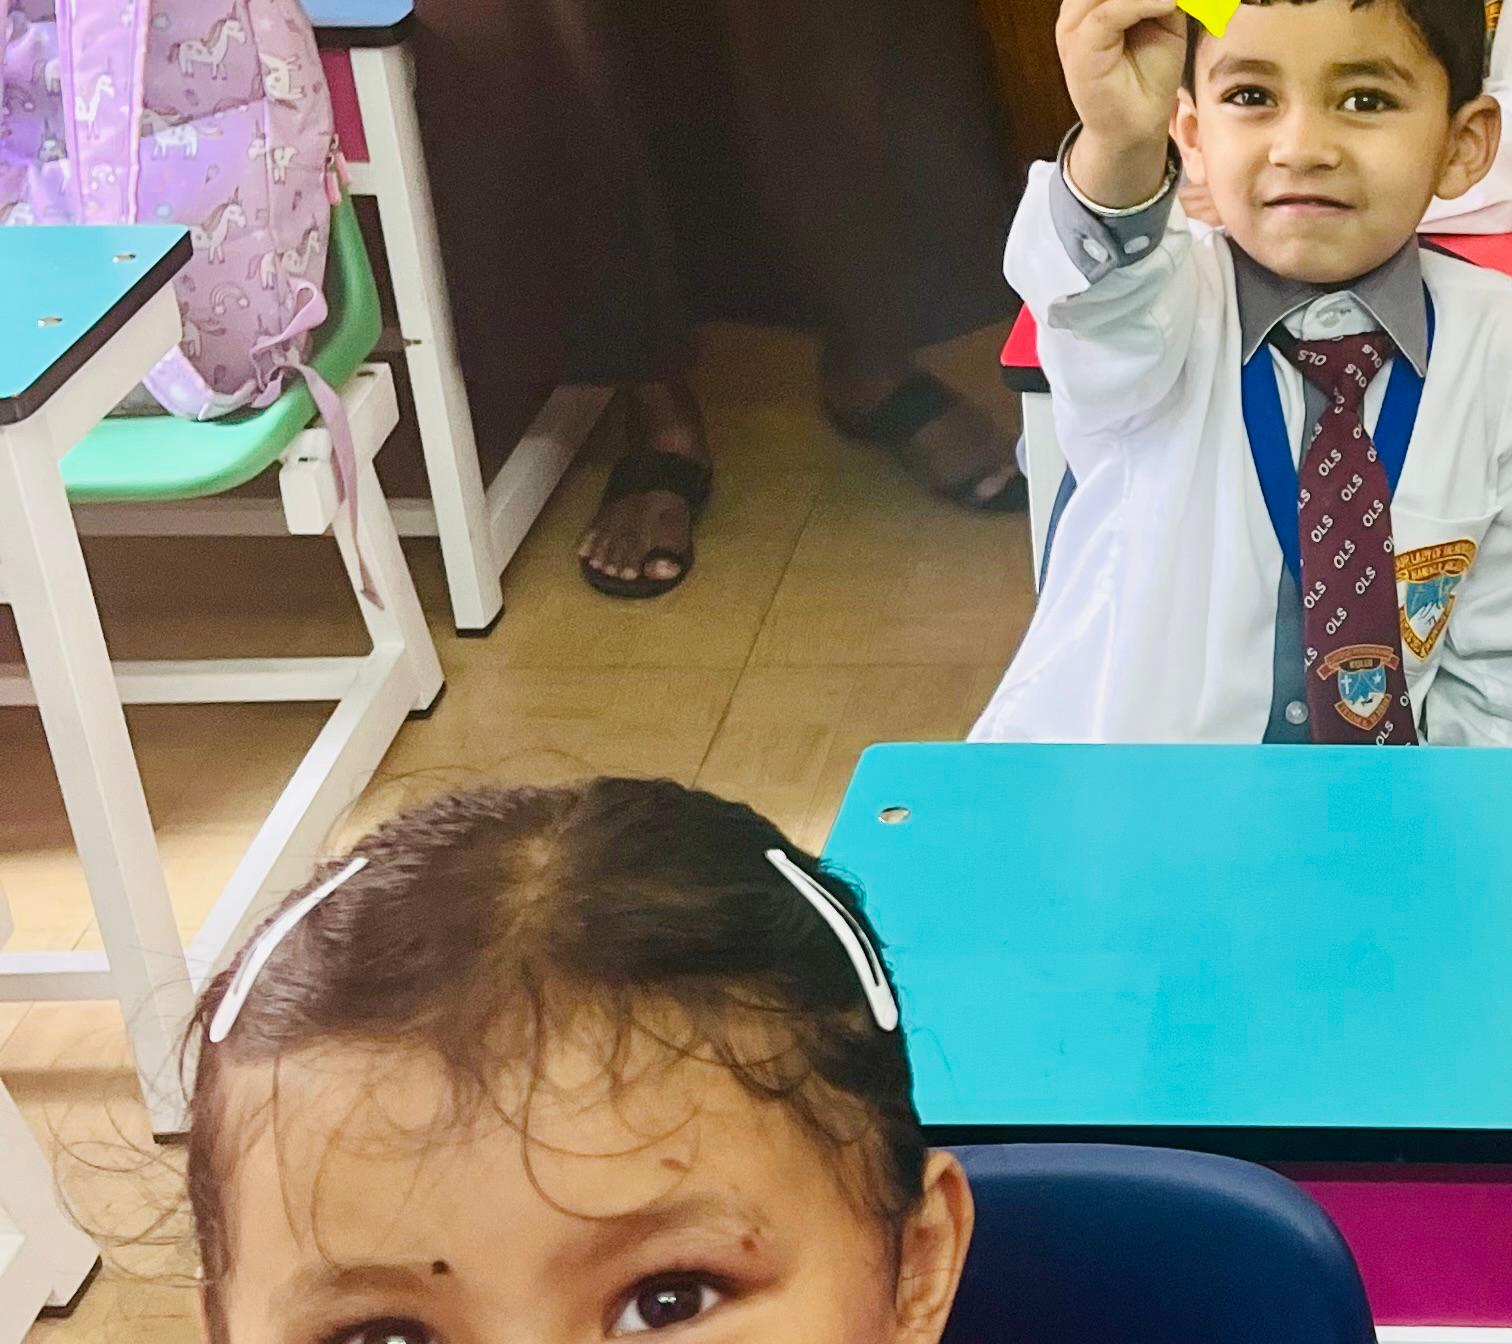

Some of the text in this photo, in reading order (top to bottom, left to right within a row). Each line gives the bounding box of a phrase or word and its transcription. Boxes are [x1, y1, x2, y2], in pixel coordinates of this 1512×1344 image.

[1297, 349, 1327, 366] OLS
[1360, 343, 1383, 369] OLS
[1344, 363, 1368, 388] OLS
[1318, 448, 1342, 477] OLS
[1341, 473, 1363, 502] OLS
[1362, 499, 1384, 527] OLS
[1310, 514, 1334, 543] OLS
[1333, 539, 1356, 569] OLS
[1303, 580, 1327, 609] OLS
[1355, 566, 1377, 595] OLS
[1325, 607, 1348, 635] OLS
[1376, 720, 1394, 746] OLS
